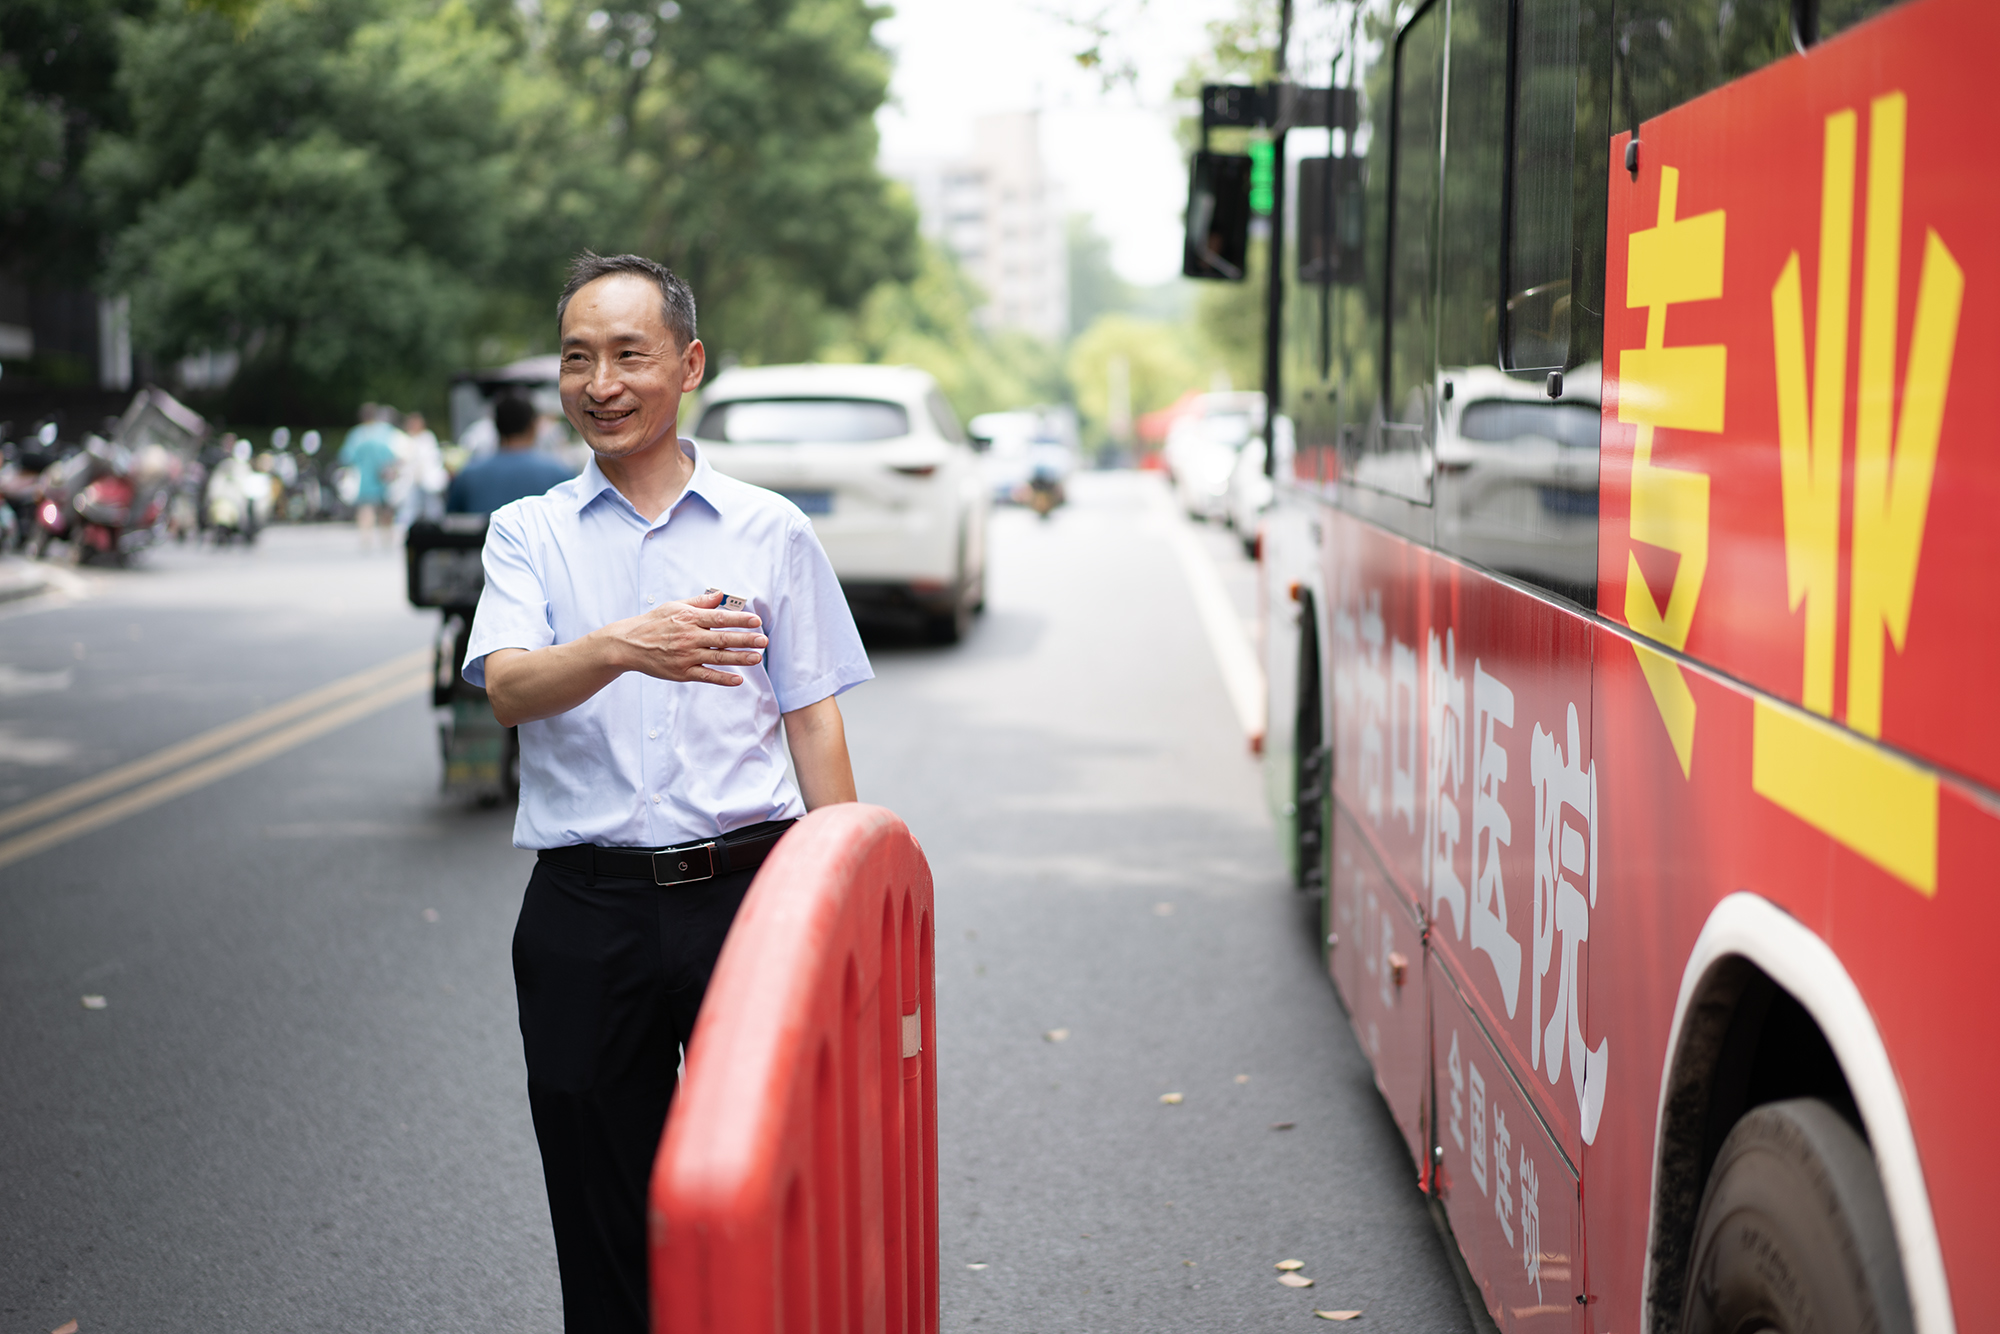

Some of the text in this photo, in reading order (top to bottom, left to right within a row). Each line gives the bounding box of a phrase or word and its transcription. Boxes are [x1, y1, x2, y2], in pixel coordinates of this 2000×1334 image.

[1618, 90, 1965, 898] 专业
[1448, 1028, 1543, 1308] 全国连锁
